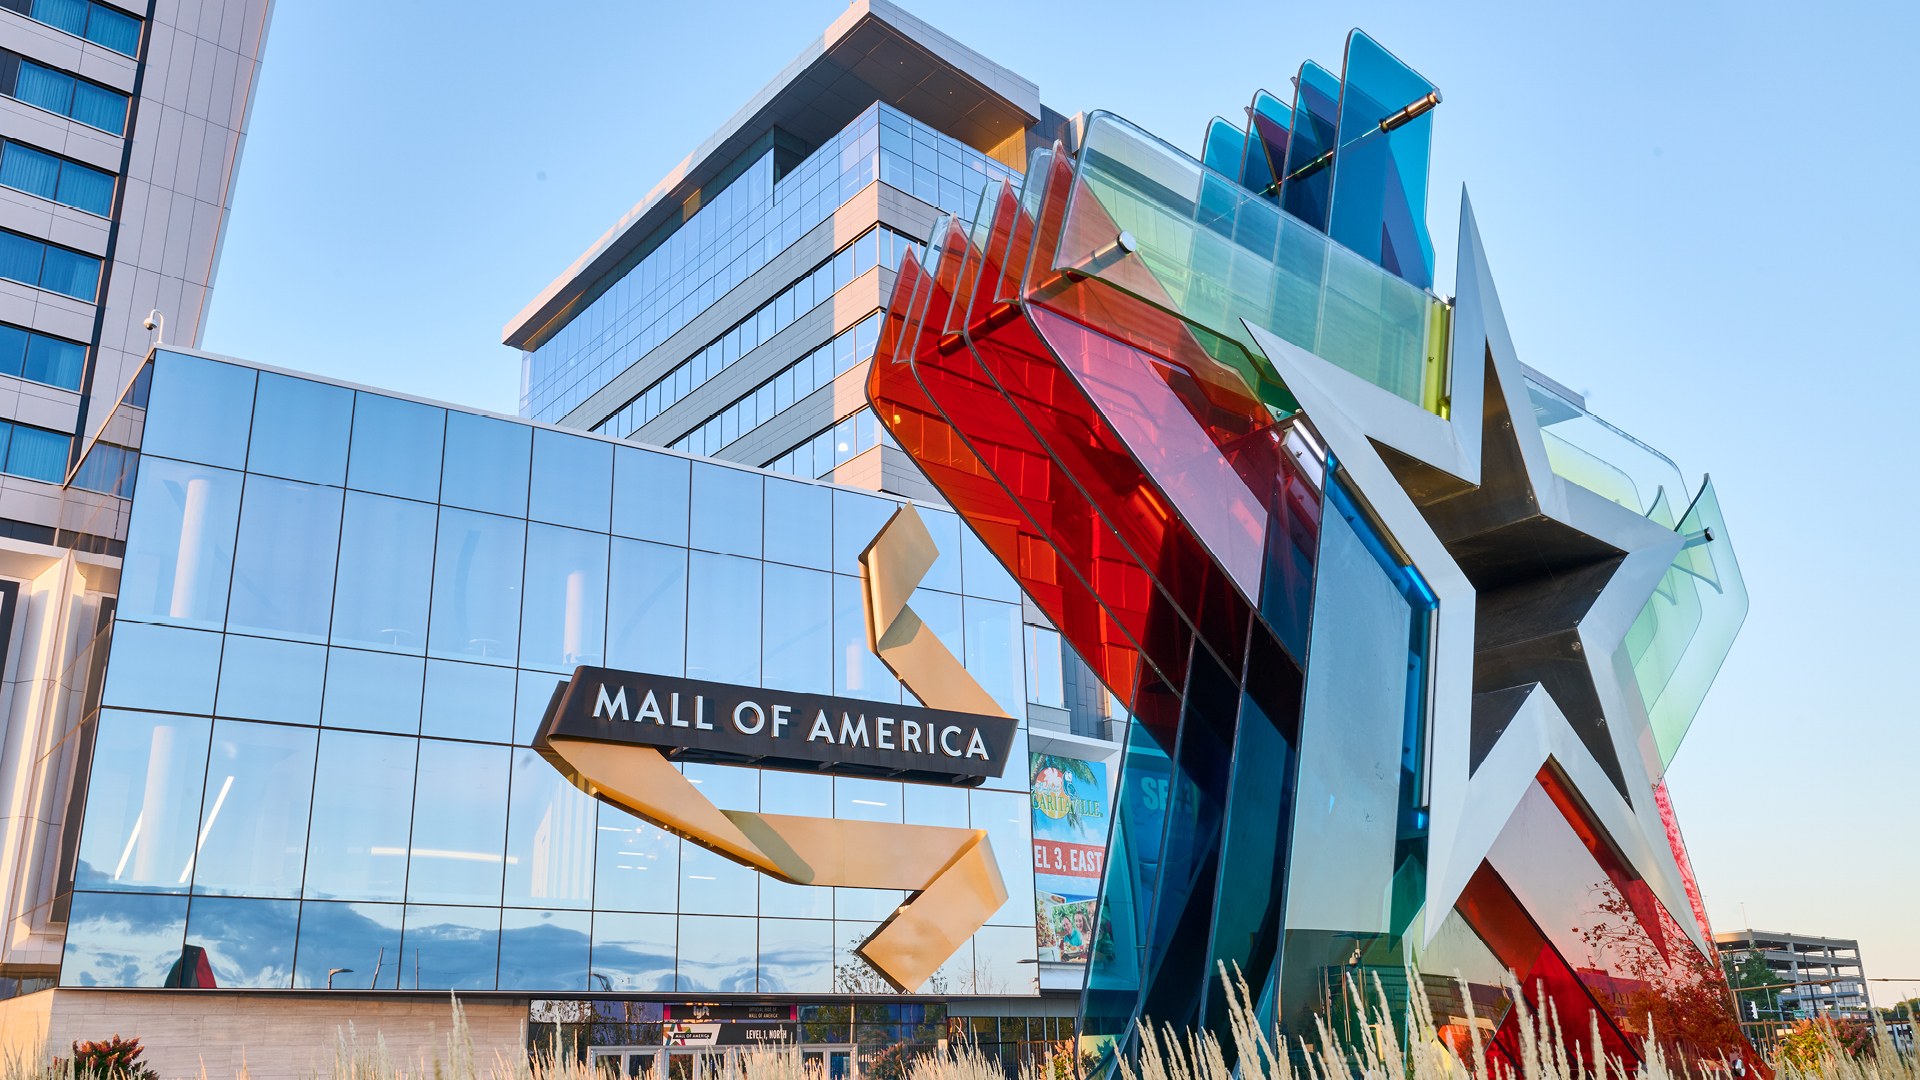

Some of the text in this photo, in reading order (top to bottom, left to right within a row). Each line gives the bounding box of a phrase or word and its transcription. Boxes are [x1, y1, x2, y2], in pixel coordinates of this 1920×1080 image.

[592, 682, 991, 761] MALL OF AMERICA
[1054, 847, 1067, 872] 3,
[1070, 849, 1103, 873] EAST
[693, 1005, 710, 1019] lyft
[746, 1030, 787, 1040] LEVEL 1, NORTH
